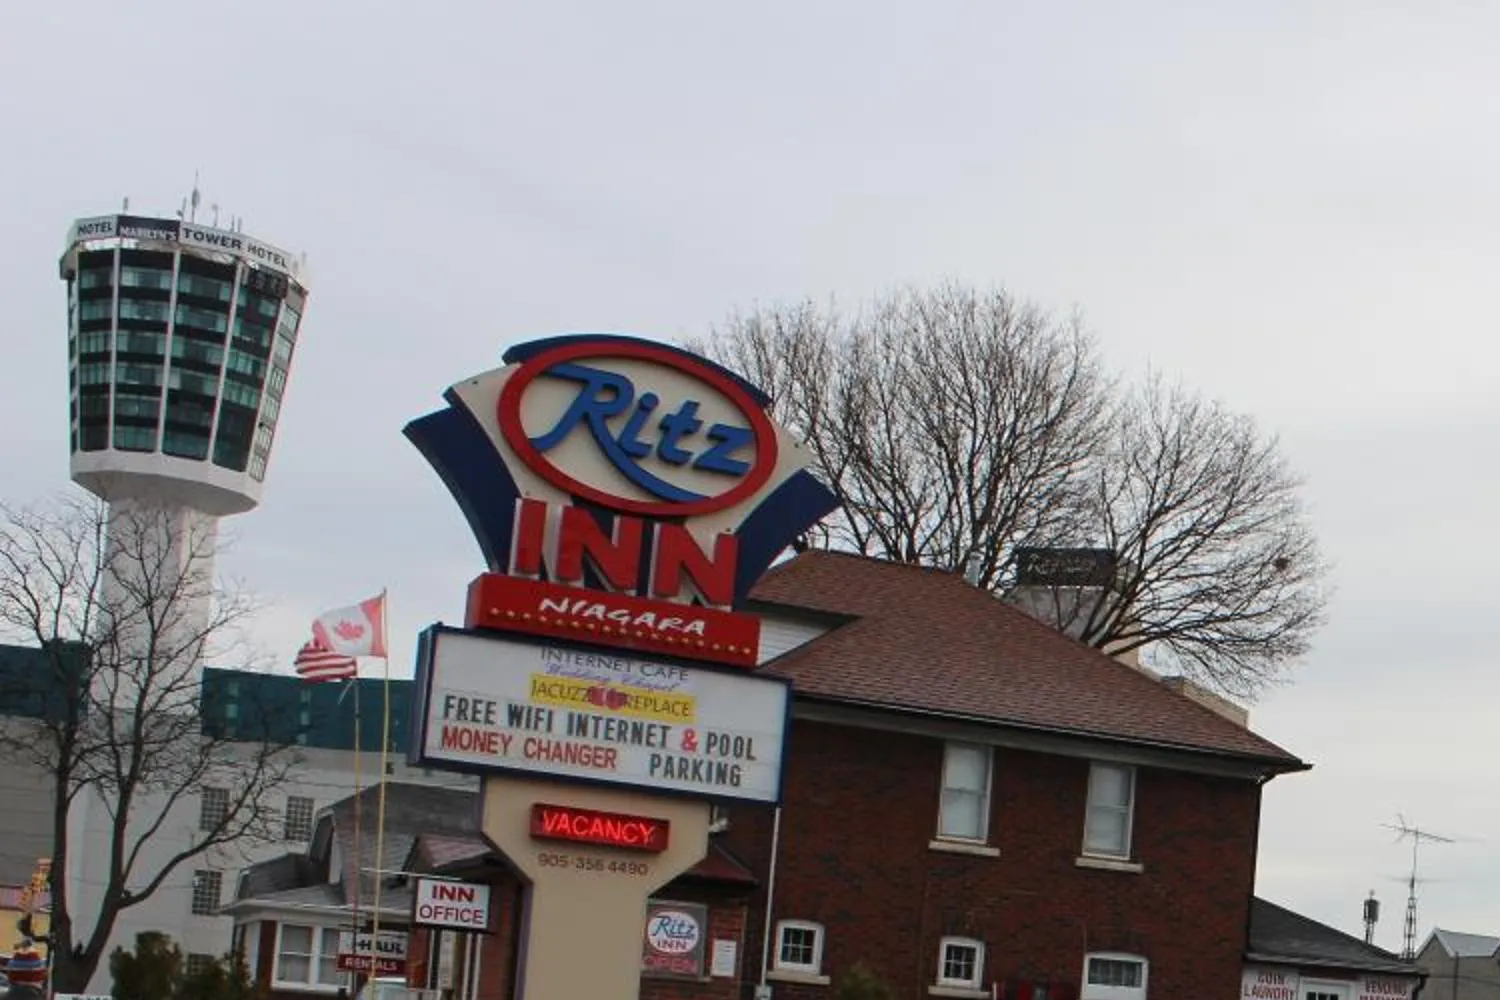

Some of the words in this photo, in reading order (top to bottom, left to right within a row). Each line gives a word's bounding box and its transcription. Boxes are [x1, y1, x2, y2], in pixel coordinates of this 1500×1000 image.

[183, 227, 242, 249] TOWER
[248, 245, 287, 268] HOTEL
[528, 362, 756, 502] Ritz
[508, 498, 738, 612] INN
[538, 597, 706, 636] NIAGARA
[541, 647, 634, 673] INTERNET
[641, 664, 689, 681] CAFE
[444, 695, 497, 726] FREE
[507, 703, 553, 733] WIFI
[567, 712, 672, 750] INTERNET
[680, 728, 698, 752] &
[706, 731, 757, 761] POOL
[441, 726, 513, 755] MONEY
[523, 737, 617, 769] CHANGER
[650, 753, 742, 787] PARKING
[543, 811, 656, 845] VACANCY
[431, 884, 475, 902] INN
[419, 904, 485, 924] OFFICE
[652, 915, 698, 939] Ritz
[657, 940, 688, 950] INN
[1244, 985, 1295, 1000] LAUNDRY
